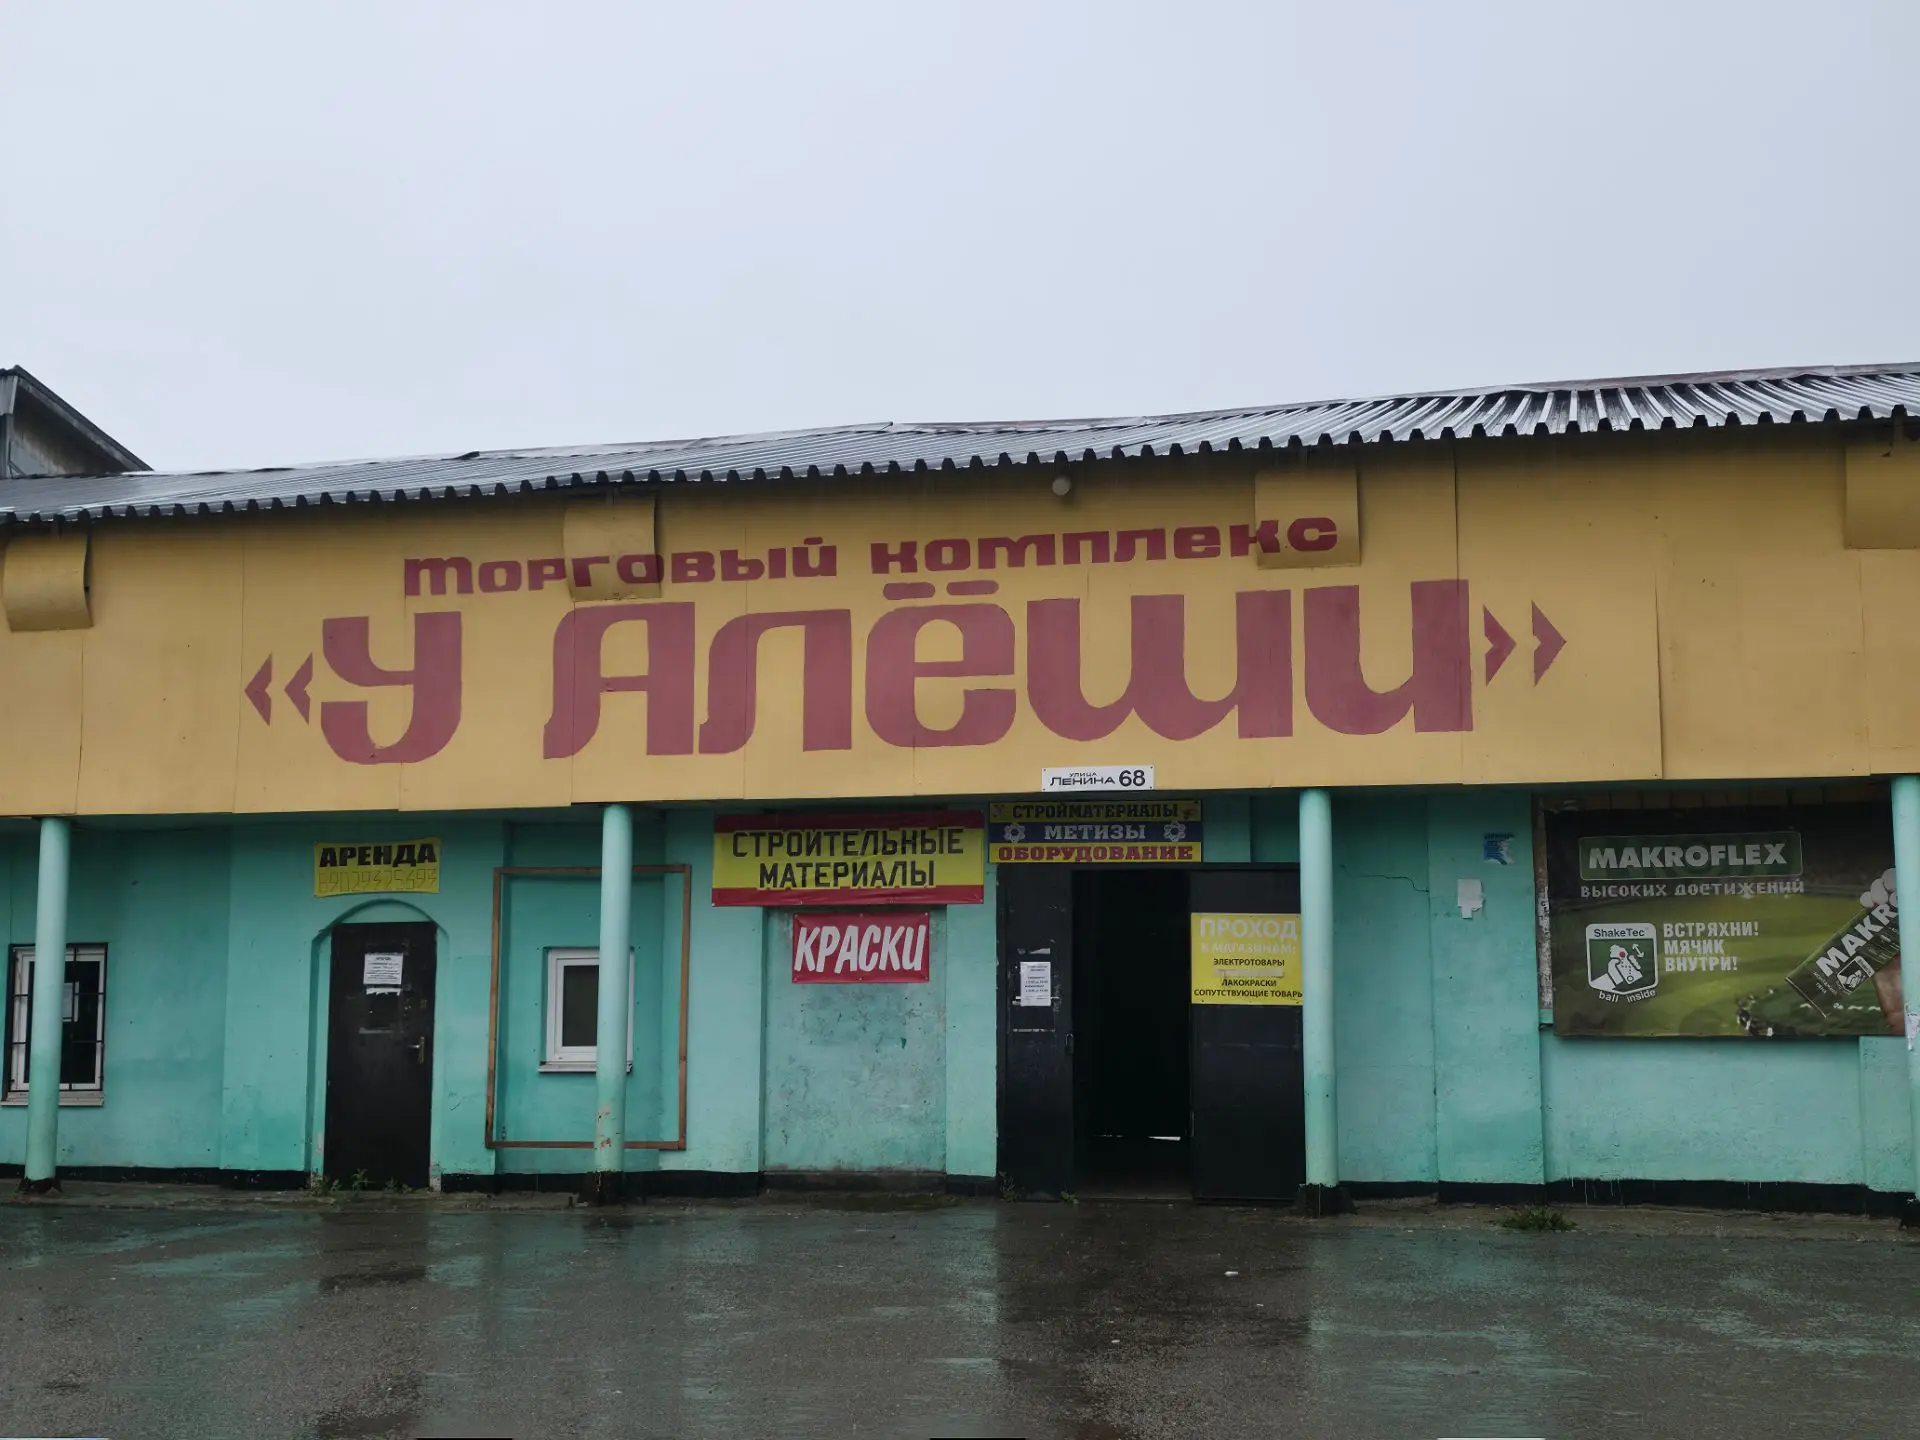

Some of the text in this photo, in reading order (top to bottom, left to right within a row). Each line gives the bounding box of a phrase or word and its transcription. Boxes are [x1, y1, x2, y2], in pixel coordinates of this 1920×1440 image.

[1119, 769, 1146, 787] 68
[1012, 802, 1178, 819] СТРОЙМАТЕРИАЛЫ
[1044, 824, 1146, 840] МЕТИЗЫ
[732, 828, 964, 858] СТРОИТЕЛЬНЫЕ
[319, 843, 438, 868] АРЕНДА
[998, 845, 1194, 863] ОБОРУДОВАНИЕ
[1589, 842, 1788, 869] MAKROFLEX
[759, 859, 935, 888] МАТЕРИАЛЫ
[1580, 878, 1805, 899] ВЫСОКИХ ДОСТИЖЕНИЙ
[1200, 918, 1298, 942] ПРОХОД
[1593, 927, 1646, 938] ShakeTec
[1663, 921, 1759, 938] ВСТРЯХНИ!
[794, 924, 927, 974] КРАСКИ
[1664, 939, 1725, 955] МЯЧИК
[1213, 958, 1285, 967] ЭЛЕКТРОТОВАРЫ
[1664, 956, 1739, 973] ВНУТРИ!
[1221, 979, 1277, 987] ЛАКОКРАСКИ
[1193, 988, 1269, 998] СОПУТСТВУЮЩИЕ
[1599, 988, 1657, 1004] ball inside
